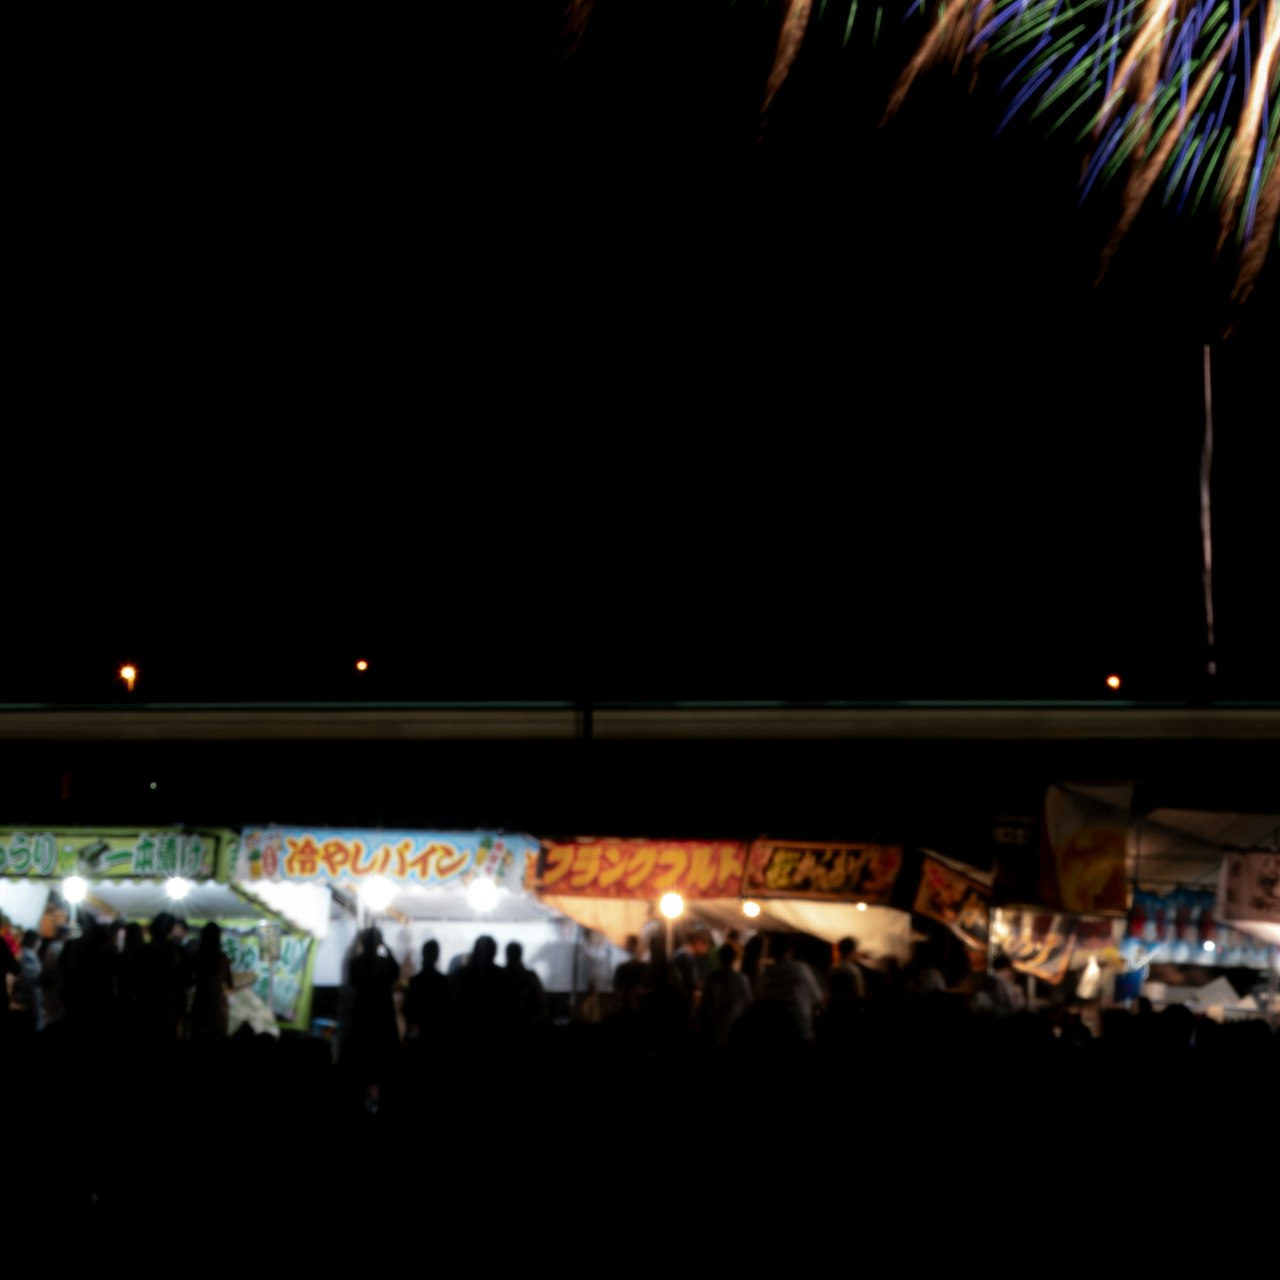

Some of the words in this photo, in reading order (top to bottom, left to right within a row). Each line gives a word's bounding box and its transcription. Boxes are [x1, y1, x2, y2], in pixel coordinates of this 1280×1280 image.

[284, 836, 470, 878] 冷やしパイン
[543, 845, 743, 890] フランクフルト
